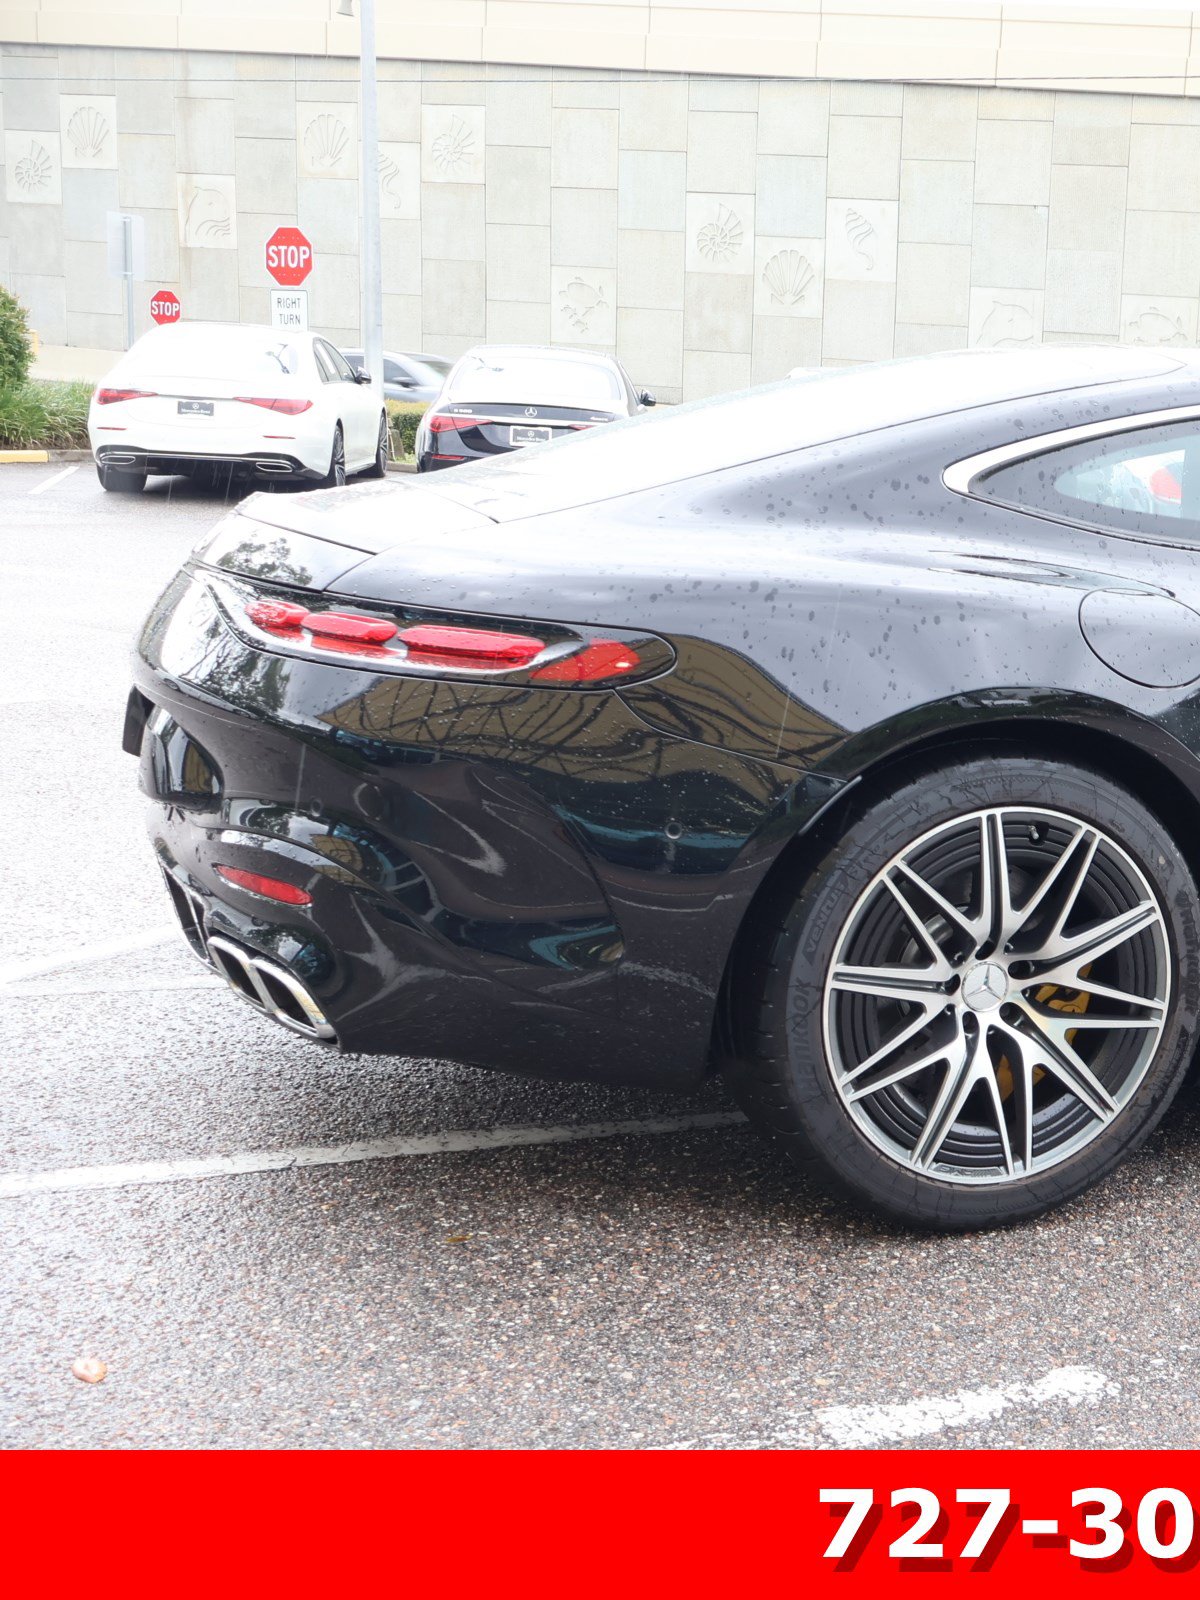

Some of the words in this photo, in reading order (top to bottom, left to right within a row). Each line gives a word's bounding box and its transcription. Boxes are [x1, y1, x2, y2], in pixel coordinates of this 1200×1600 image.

[268, 245, 310, 268] STOP
[151, 301, 180, 316] STOP
[277, 297, 301, 309] RIGHT
[279, 313, 301, 325] TURN
